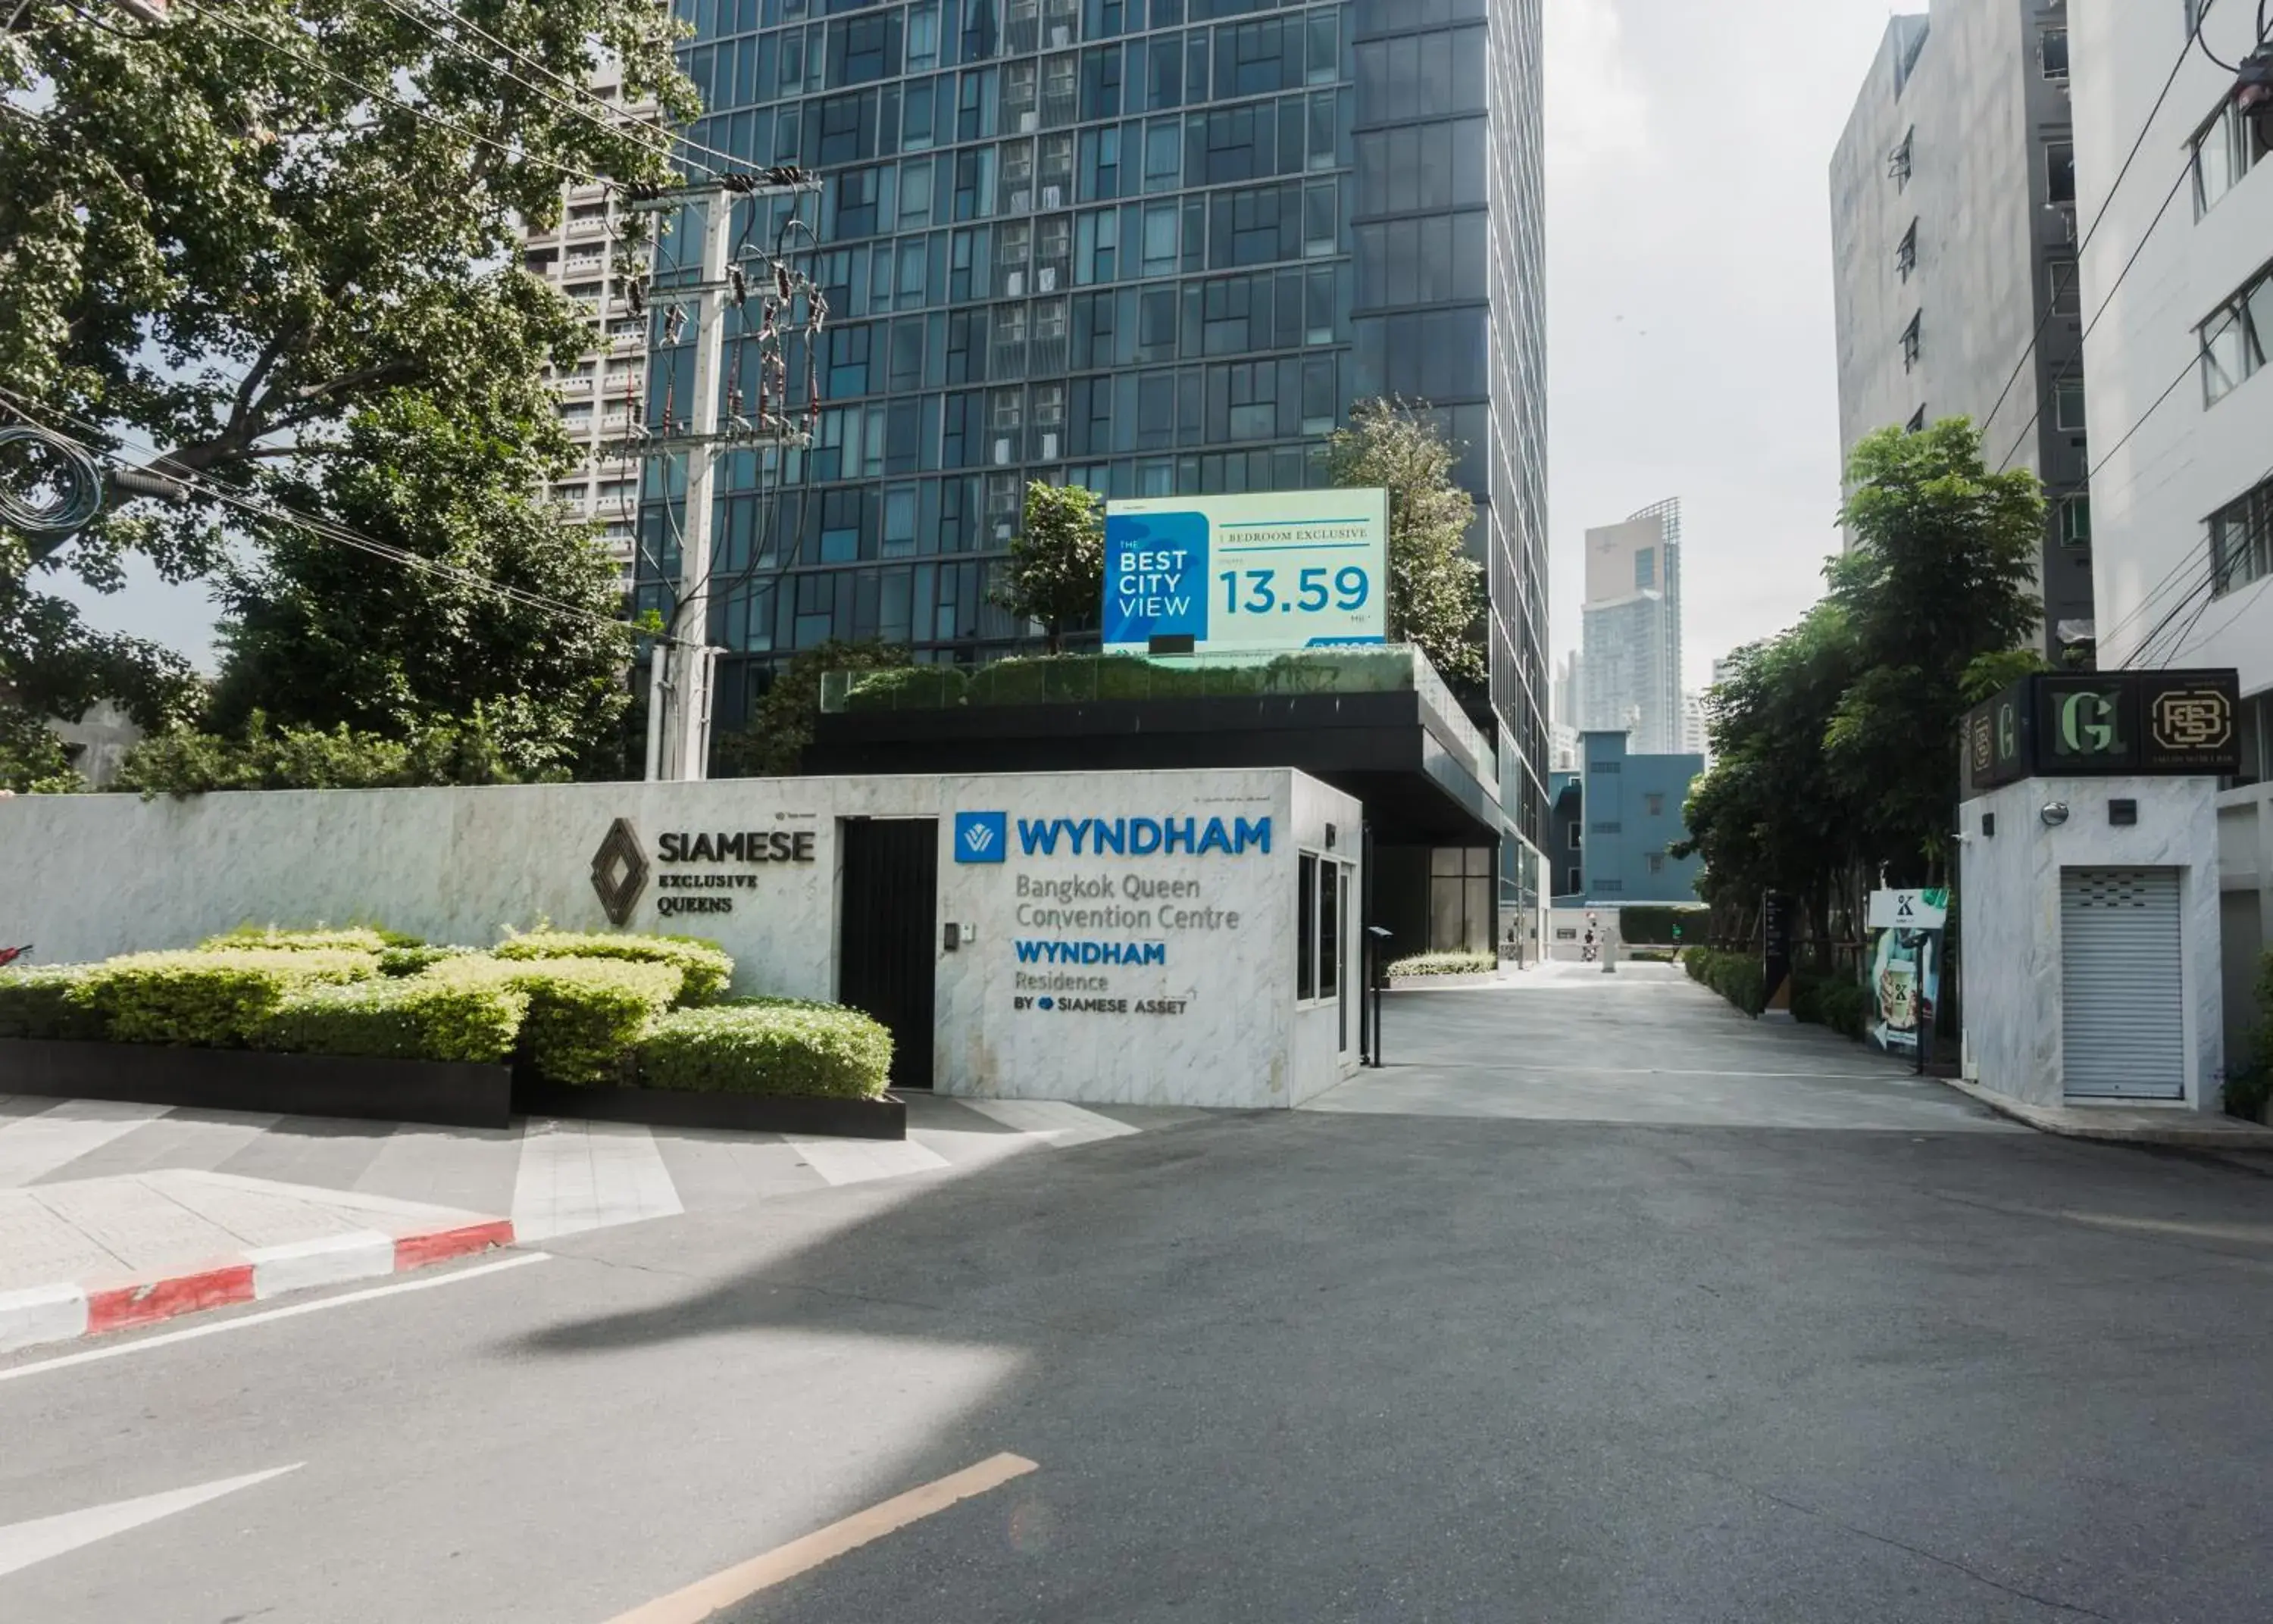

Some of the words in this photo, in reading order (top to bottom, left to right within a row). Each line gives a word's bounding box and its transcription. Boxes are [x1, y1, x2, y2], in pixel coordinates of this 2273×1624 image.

[1120, 540, 1139, 549] THE
[1228, 531, 1292, 543] BEDROOM
[1296, 527, 1368, 541] EXCLUSIVE
[1120, 550, 1187, 572] BEST
[1119, 573, 1181, 595] CITY
[1219, 565, 1369, 614] 13.59
[1119, 596, 1191, 617] VIEW
[658, 831, 815, 862] SIAMESE
[1018, 817, 1271, 855] WYNDHAM
[658, 875, 758, 889] EXCLUSIVE
[1016, 874, 1115, 904] Bangkok
[1121, 875, 1200, 900] Queen
[657, 896, 733, 917] QUEENS
[1016, 903, 1150, 928] Convention
[1158, 904, 1239, 929] Centre
[1015, 941, 1165, 965] WYNDHAM
[1015, 971, 1108, 992] Residence
[1014, 997, 1033, 1011] BY
[1058, 998, 1127, 1012] SIAMESE
[1134, 1000, 1187, 1014] ASSET
